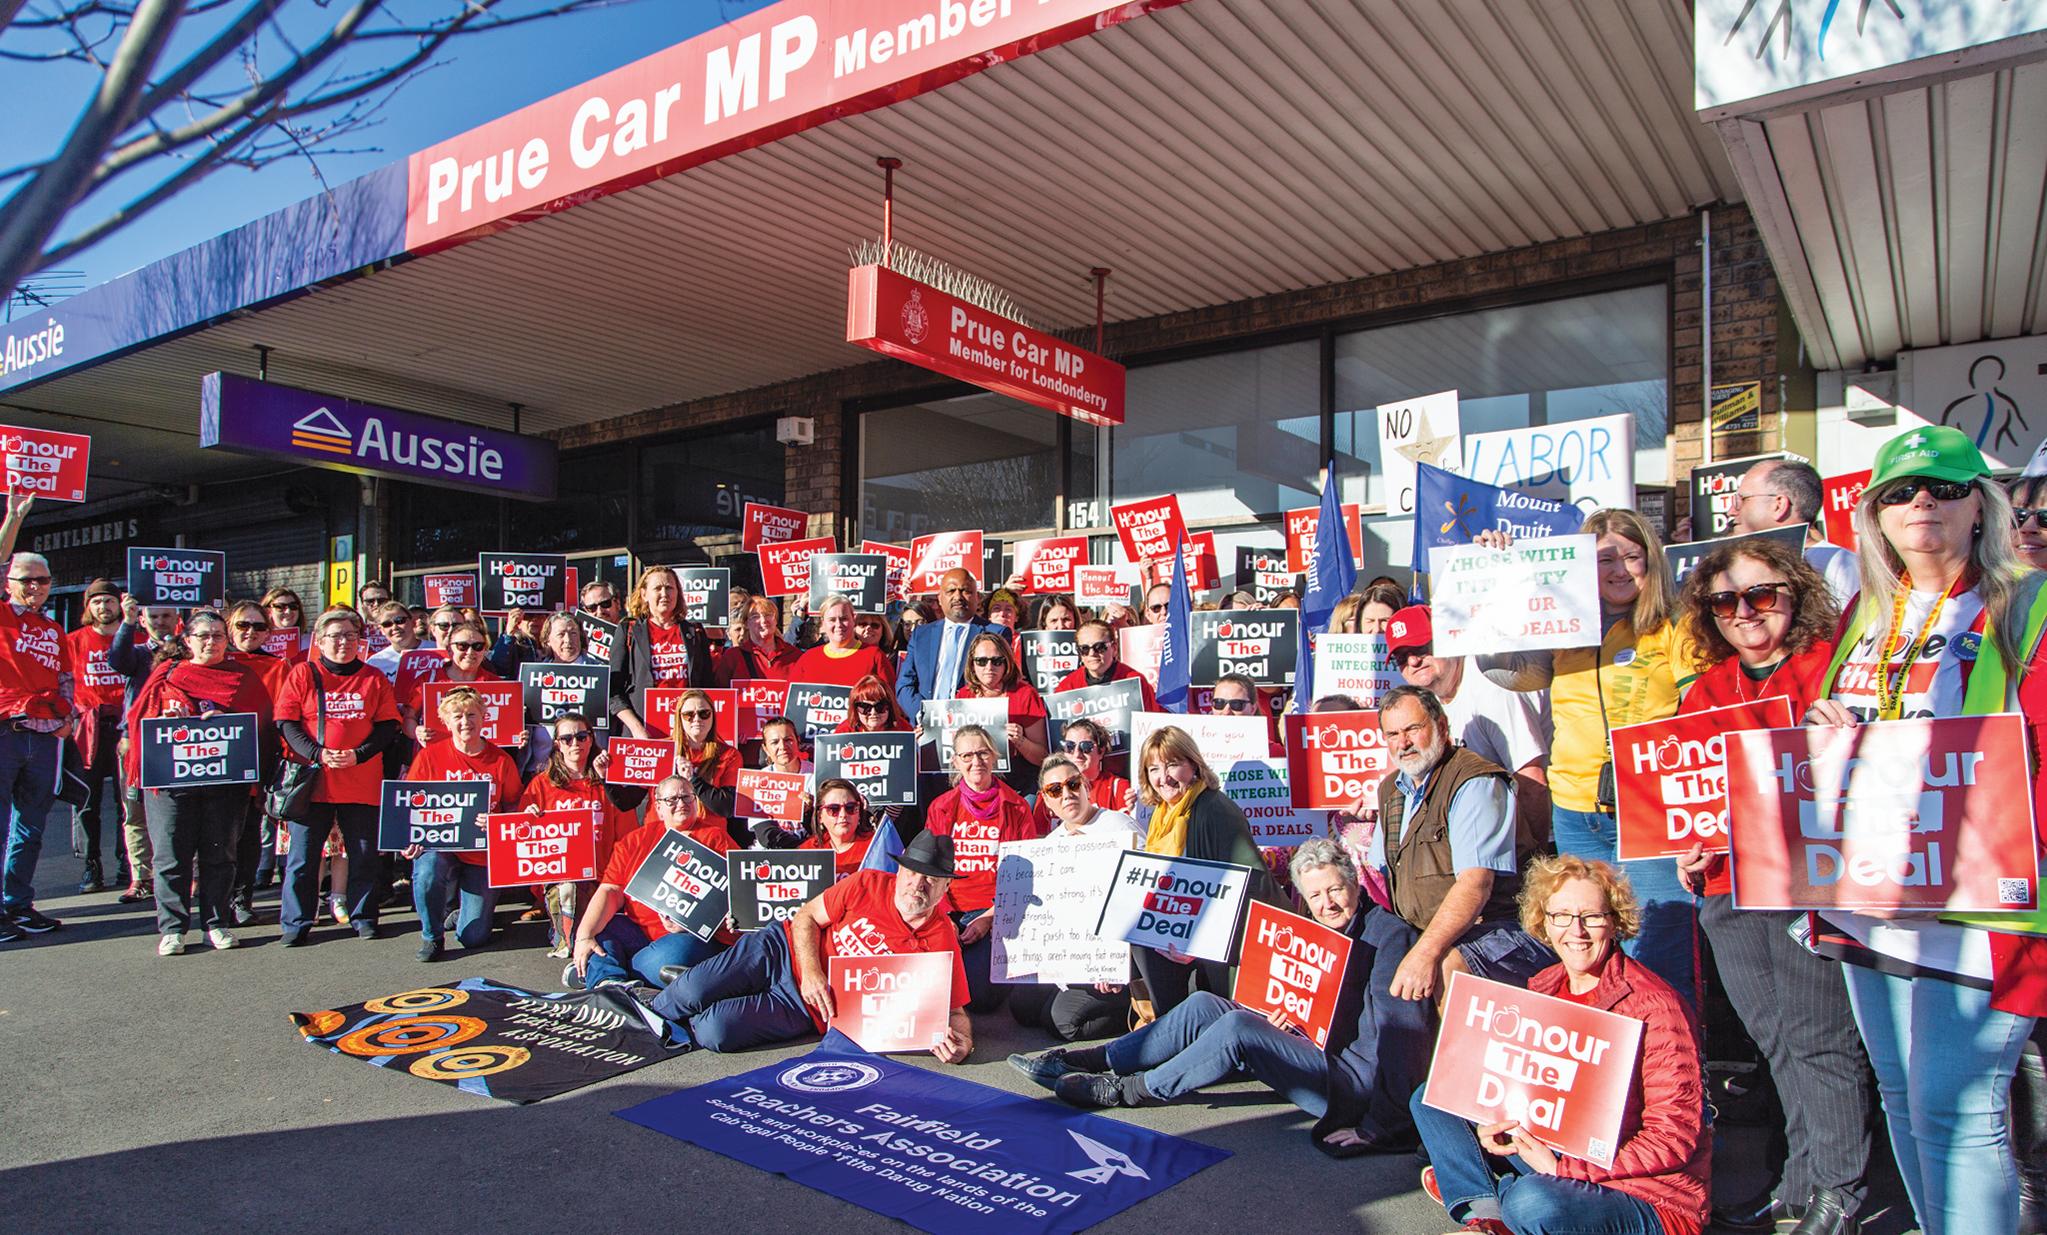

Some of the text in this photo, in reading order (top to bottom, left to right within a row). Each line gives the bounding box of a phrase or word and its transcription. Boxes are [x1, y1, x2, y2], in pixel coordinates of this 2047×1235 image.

[426, 136, 548, 224] Prue
[570, 84, 681, 169] Car
[704, 14, 818, 125] MP
[4, 318, 65, 374] Aussie
[951, 306, 1005, 350] Prue
[1012, 331, 1049, 366] Car
[1055, 347, 1084, 378] MP
[950, 337, 1107, 411] Member for Londonderry
[1386, 408, 1412, 440] NO
[358, 418, 503, 481] Aussie
[1470, 428, 1612, 487] LABOR
[18, 456, 51, 471] The
[7, 471, 57, 491] Deal
[1496, 490, 1562, 513] Mount
[753, 510, 801, 528] Honour
[1068, 502, 1098, 528] 154
[1117, 505, 1171, 527] Honour
[768, 528, 786, 538] The
[1136, 527, 1159, 538] The
[1497, 518, 1552, 538] Druitt
[1137, 541, 1170, 556] Deal
[1520, 547, 1575, 562] WITH
[140, 555, 214, 573] Honour
[490, 561, 556, 576] Honour
[818, 562, 877, 576] Honour
[934, 559, 956, 569] The
[1039, 562, 1064, 572] The
[164, 573, 194, 585] The
[511, 578, 539, 588] The
[835, 579, 859, 588] The
[1033, 574, 1069, 588] Deal
[1264, 574, 1289, 586] The
[156, 586, 199, 601] Deal
[504, 591, 543, 605] Deal
[1203, 620, 1285, 638] Honour
[1228, 642, 1261, 655] The
[1327, 643, 1368, 653] THOSE
[1219, 659, 1268, 677] Deal
[529, 672, 598, 690] Honour
[1338, 678, 1391, 689] HONOUR
[550, 691, 578, 702] The
[1057, 692, 1129, 718] Honour
[815, 711, 841, 722] The
[156, 725, 243, 744] Honour
[183, 745, 220, 757] The
[617, 744, 666, 757] Honour
[827, 742, 902, 760] Honour
[174, 759, 226, 778] Deal
[633, 758, 652, 766] The
[850, 764, 881, 775] The
[1334, 754, 1377, 769] The
[624, 768, 655, 779] Deal
[1220, 769, 1264, 782] THOSE
[1759, 751, 1984, 794] Honour
[742, 776, 801, 791] #Honour
[395, 789, 477, 808] Honour
[760, 790, 781, 800] The
[420, 811, 454, 823] The
[754, 802, 784, 814] Deal
[410, 826, 460, 843] Deal
[500, 821, 581, 841] Honour
[952, 821, 999, 838] More
[1266, 823, 1313, 836] DEALS
[526, 842, 559, 854] The
[954, 842, 989, 853] than
[1030, 847, 1053, 857] seem
[1058, 844, 1070, 853] too
[518, 857, 566, 876] Deal
[663, 841, 728, 892] Honour
[740, 860, 822, 881] Honour
[1048, 863, 1054, 876] I
[1060, 865, 1075, 874] care
[1805, 843, 1942, 886] Deal
[673, 871, 701, 895] The
[767, 884, 799, 899] The
[1126, 867, 1231, 900] #Honour
[653, 881, 698, 918] Deal
[1156, 895, 1193, 915] The
[758, 902, 801, 922] Dea
[1136, 911, 1195, 939] Deal
[1043, 930, 1064, 946] push
[1257, 919, 1337, 972] Honour
[1281, 959, 1313, 988] The
[1265, 982, 1312, 1022] Deal
[1465, 996, 1610, 1065] Honour
[1503, 1047, 1560, 1085] The
[854, 1103, 1002, 1150] Fairfield
[730, 1087, 1082, 1207] Teachers Association
[762, 1118, 795, 1130] and
[881, 1156, 905, 1168] on
[905, 1164, 936, 1178] the
[937, 1175, 988, 1196] lands
[1013, 1202, 1047, 1217] the
[774, 1133, 995, 1215] People the Darug Nation
